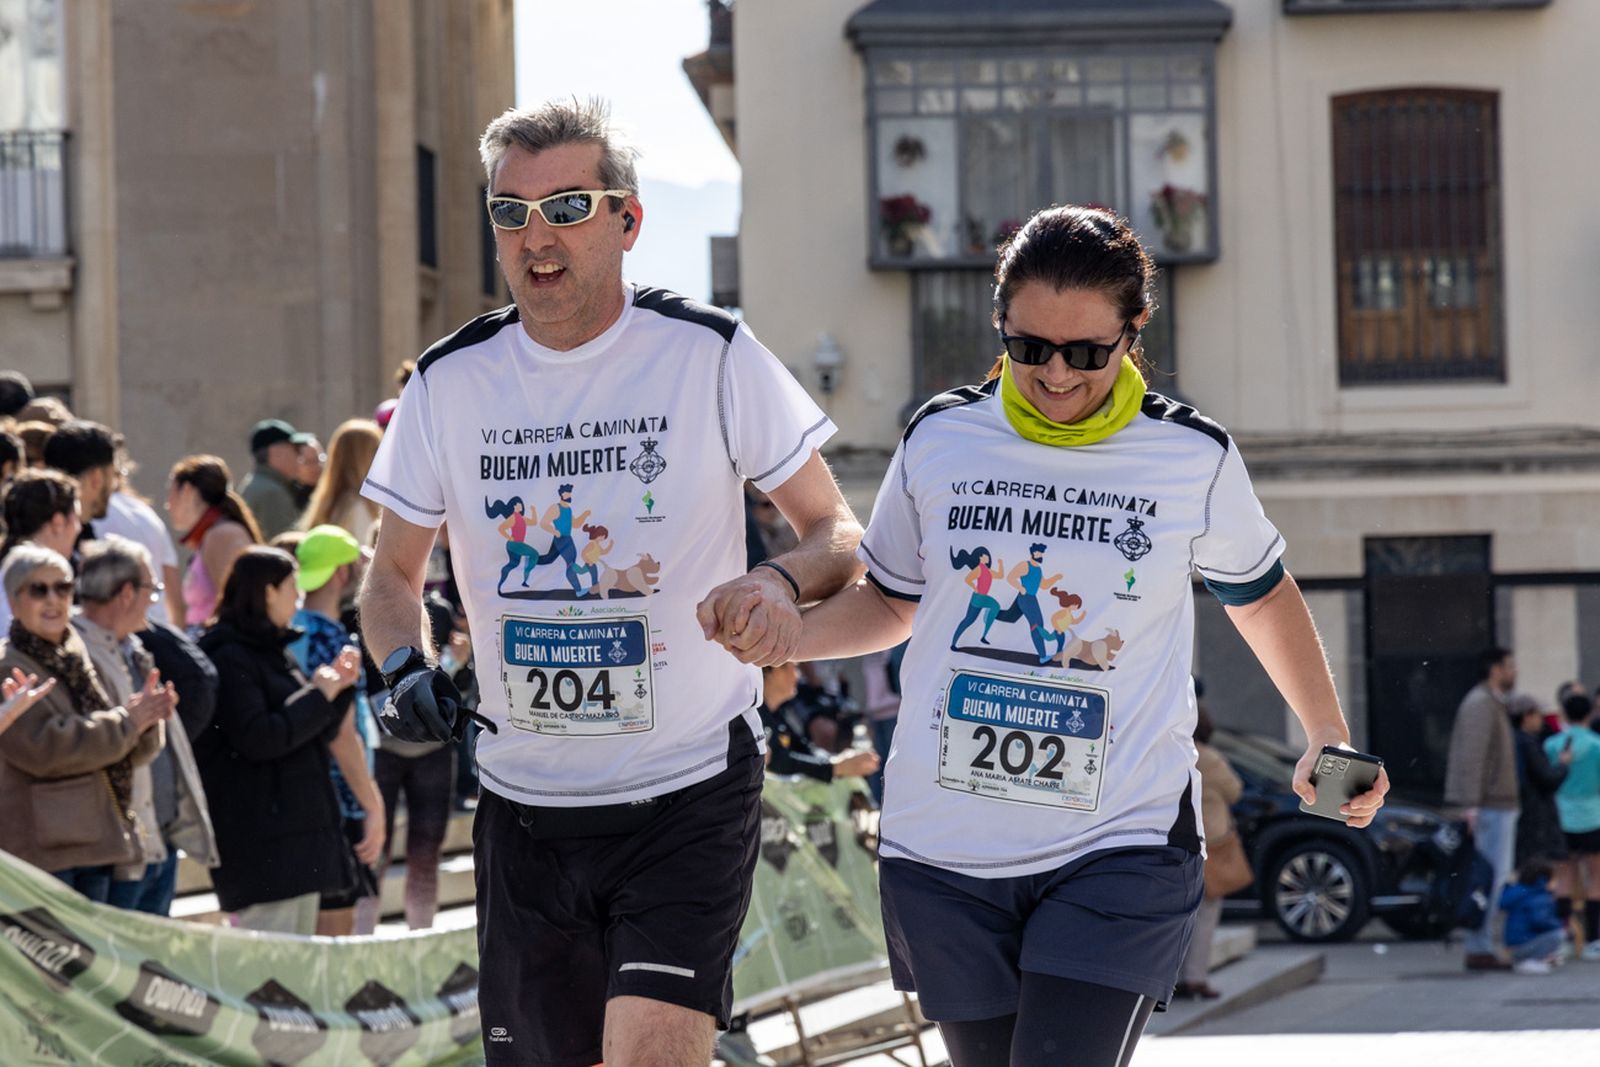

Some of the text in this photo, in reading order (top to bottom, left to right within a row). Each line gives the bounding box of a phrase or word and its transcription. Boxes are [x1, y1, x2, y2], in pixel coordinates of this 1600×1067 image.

[481, 415, 668, 445] VI CARRERA CAMINATA
[480, 446, 627, 480] BUENA MUERTE
[952, 479, 1157, 517] VI CARRERA CAMINATA
[948, 505, 1113, 543] BUENA MUERTE
[515, 627, 627, 640] VI CARRERA CAMINATA
[515, 643, 602, 663] BUENA MUERTE
[526, 668, 616, 712] 204
[968, 681, 1088, 708] VI CARRERA CAMINATA
[529, 710, 549, 719] MANUEL
[559, 711, 585, 720] CASTRO
[962, 697, 1001, 721] BUENA
[1005, 705, 1060, 729] MUERTE
[970, 726, 1066, 780] 202
[971, 770, 983, 778] ANA
[984, 772, 1007, 781] MARIA
